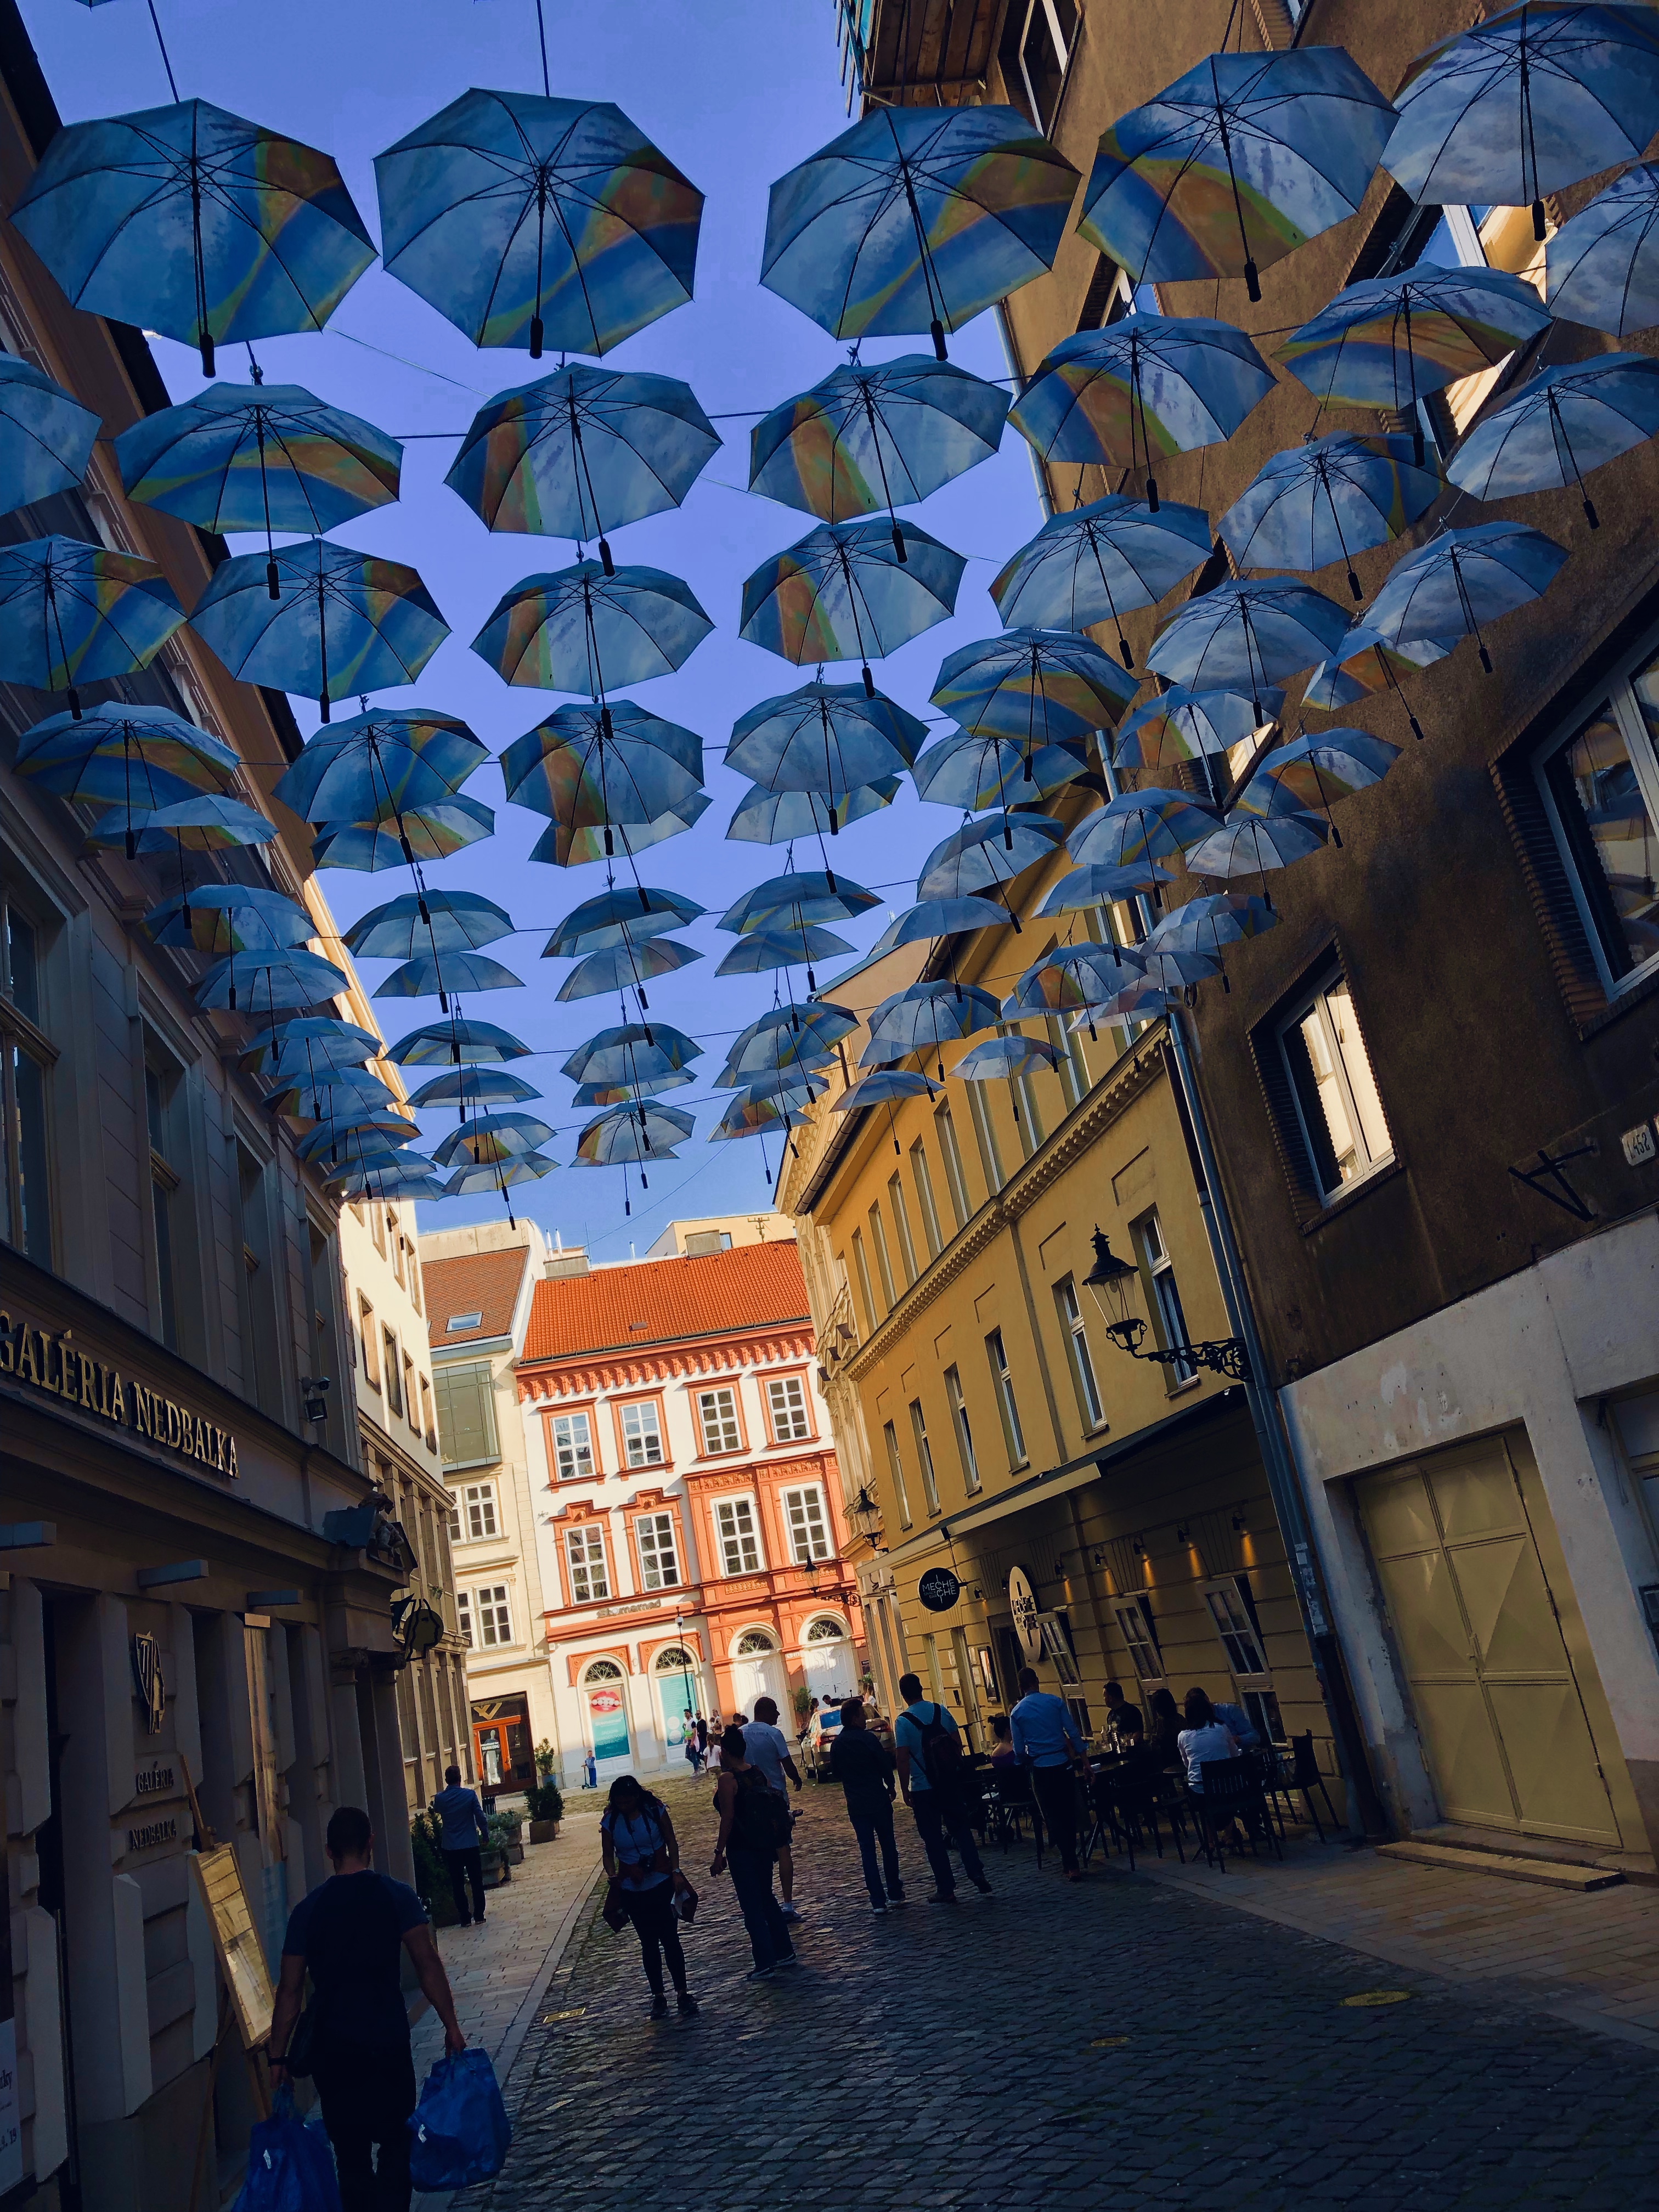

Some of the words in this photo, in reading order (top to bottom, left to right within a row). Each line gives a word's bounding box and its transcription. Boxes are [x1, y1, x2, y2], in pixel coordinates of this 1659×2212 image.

[0, 1309, 128, 1426] GALÉRIA
[132, 1381, 240, 1480] NEDBALKA
[922, 1578, 955, 1592] MECHE
[936, 1587, 957, 1598] CHE
[1011, 1595, 1036, 1616] MECHE
[136, 1760, 174, 1793] GALÉRIA
[129, 1819, 177, 1850] NEDBALKA
